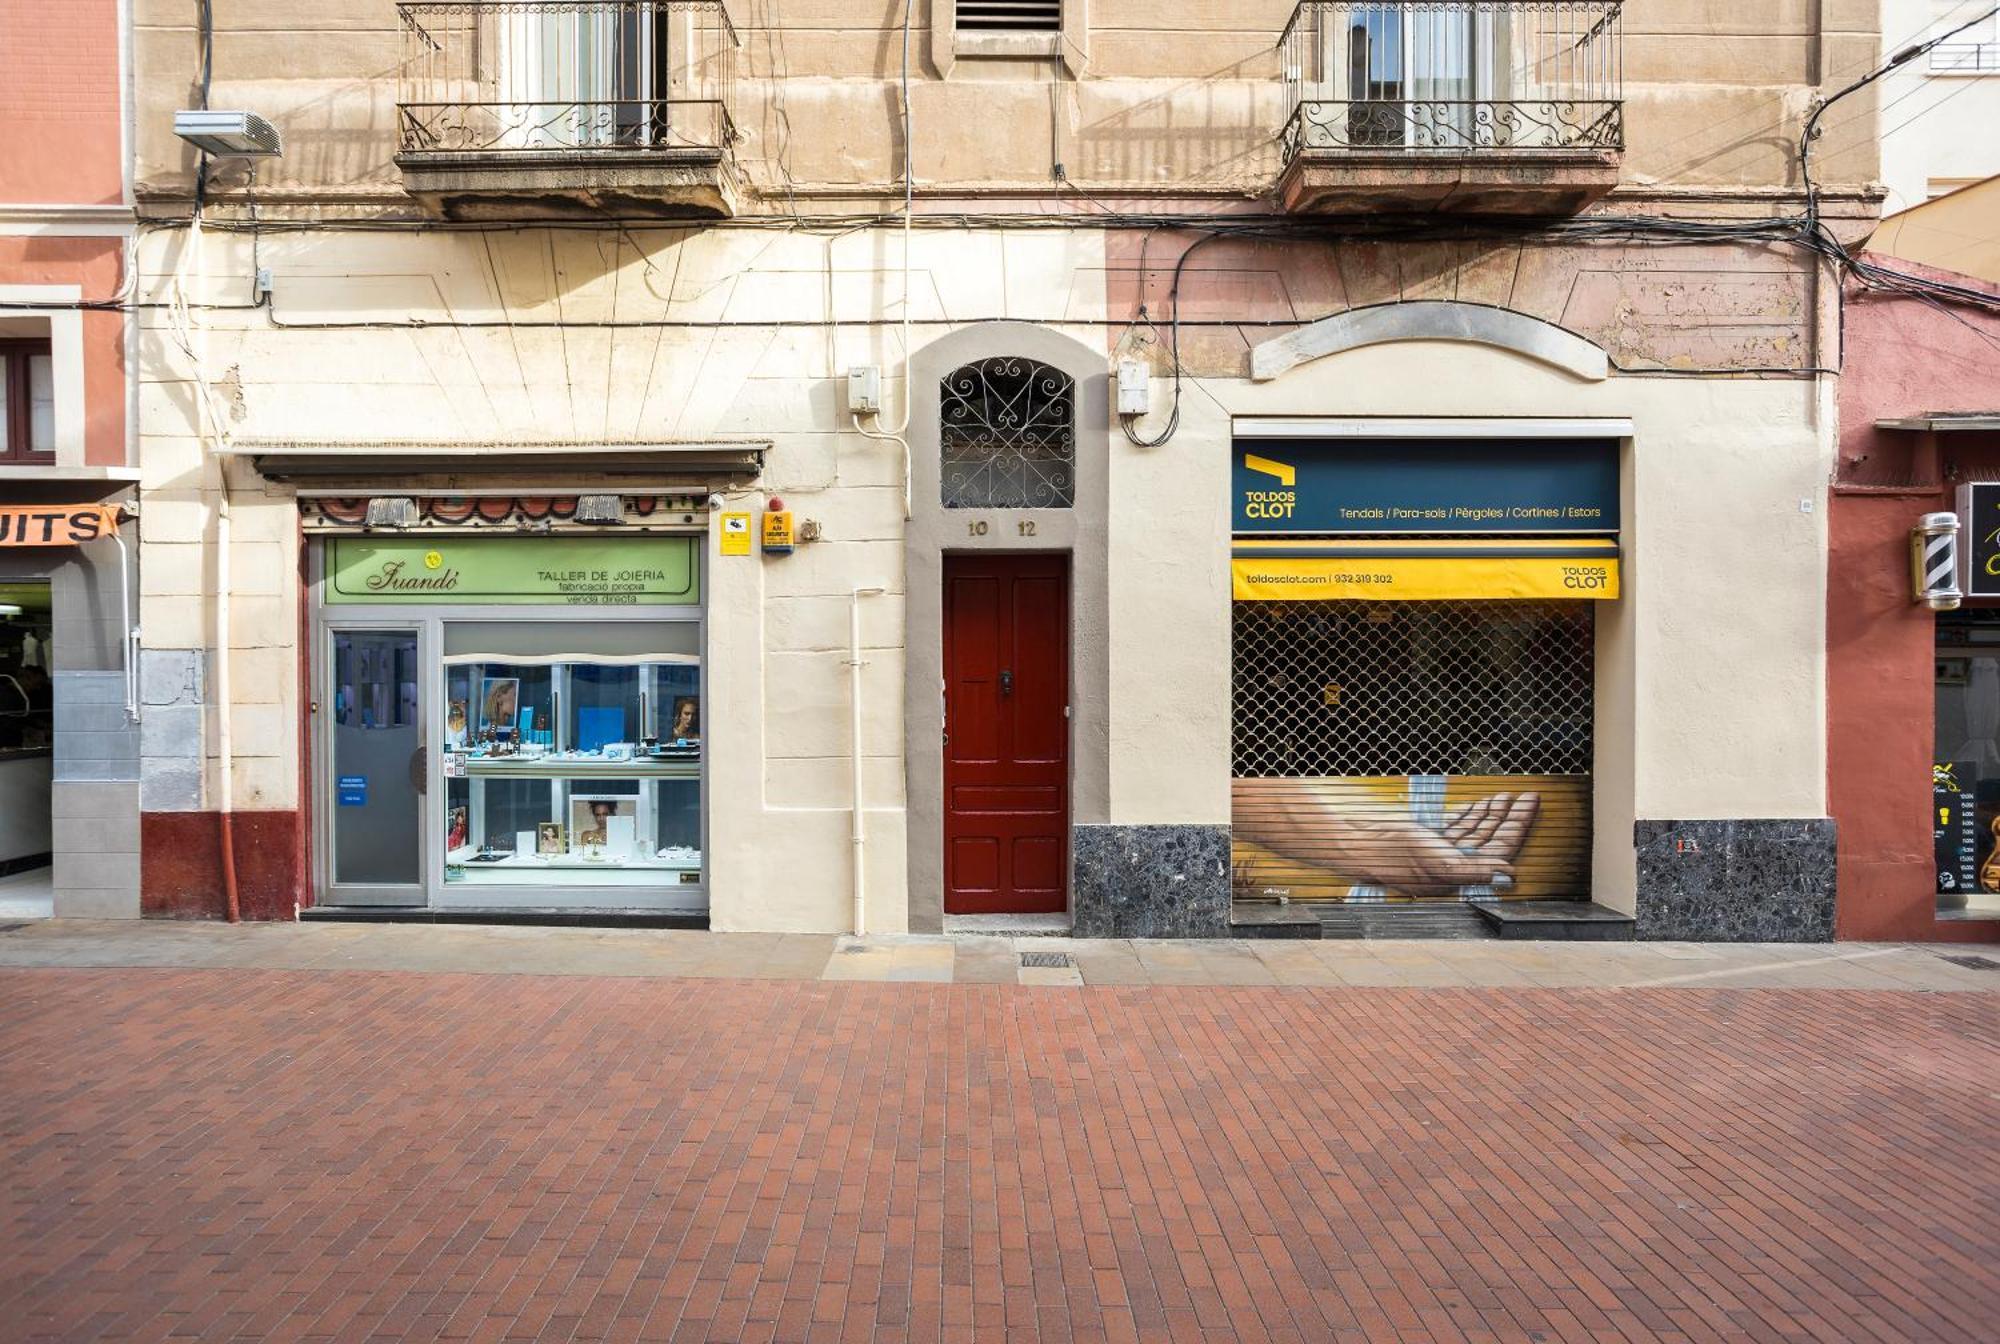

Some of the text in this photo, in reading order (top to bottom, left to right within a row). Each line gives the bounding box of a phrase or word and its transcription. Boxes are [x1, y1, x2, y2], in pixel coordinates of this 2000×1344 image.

[1246, 491, 1296, 502] TOLDOS
[1246, 503, 1296, 518] CLOT
[1340, 507, 1384, 518] Tendals
[1393, 507, 1446, 518] Para-sols
[1512, 507, 1559, 518] Cortines
[1568, 507, 1601, 517] Estors
[968, 520, 1036, 537] 10 12
[537, 570, 665, 581] TALLER DE JOIERIA
[1562, 567, 1607, 576] TOLDOS
[1247, 574, 1327, 584] toldosclot.com
[1334, 574, 1353, 584] 932
[1355, 574, 1372, 584] 319
[1374, 574, 1393, 584] 302
[1563, 576, 1608, 589] CLOT
